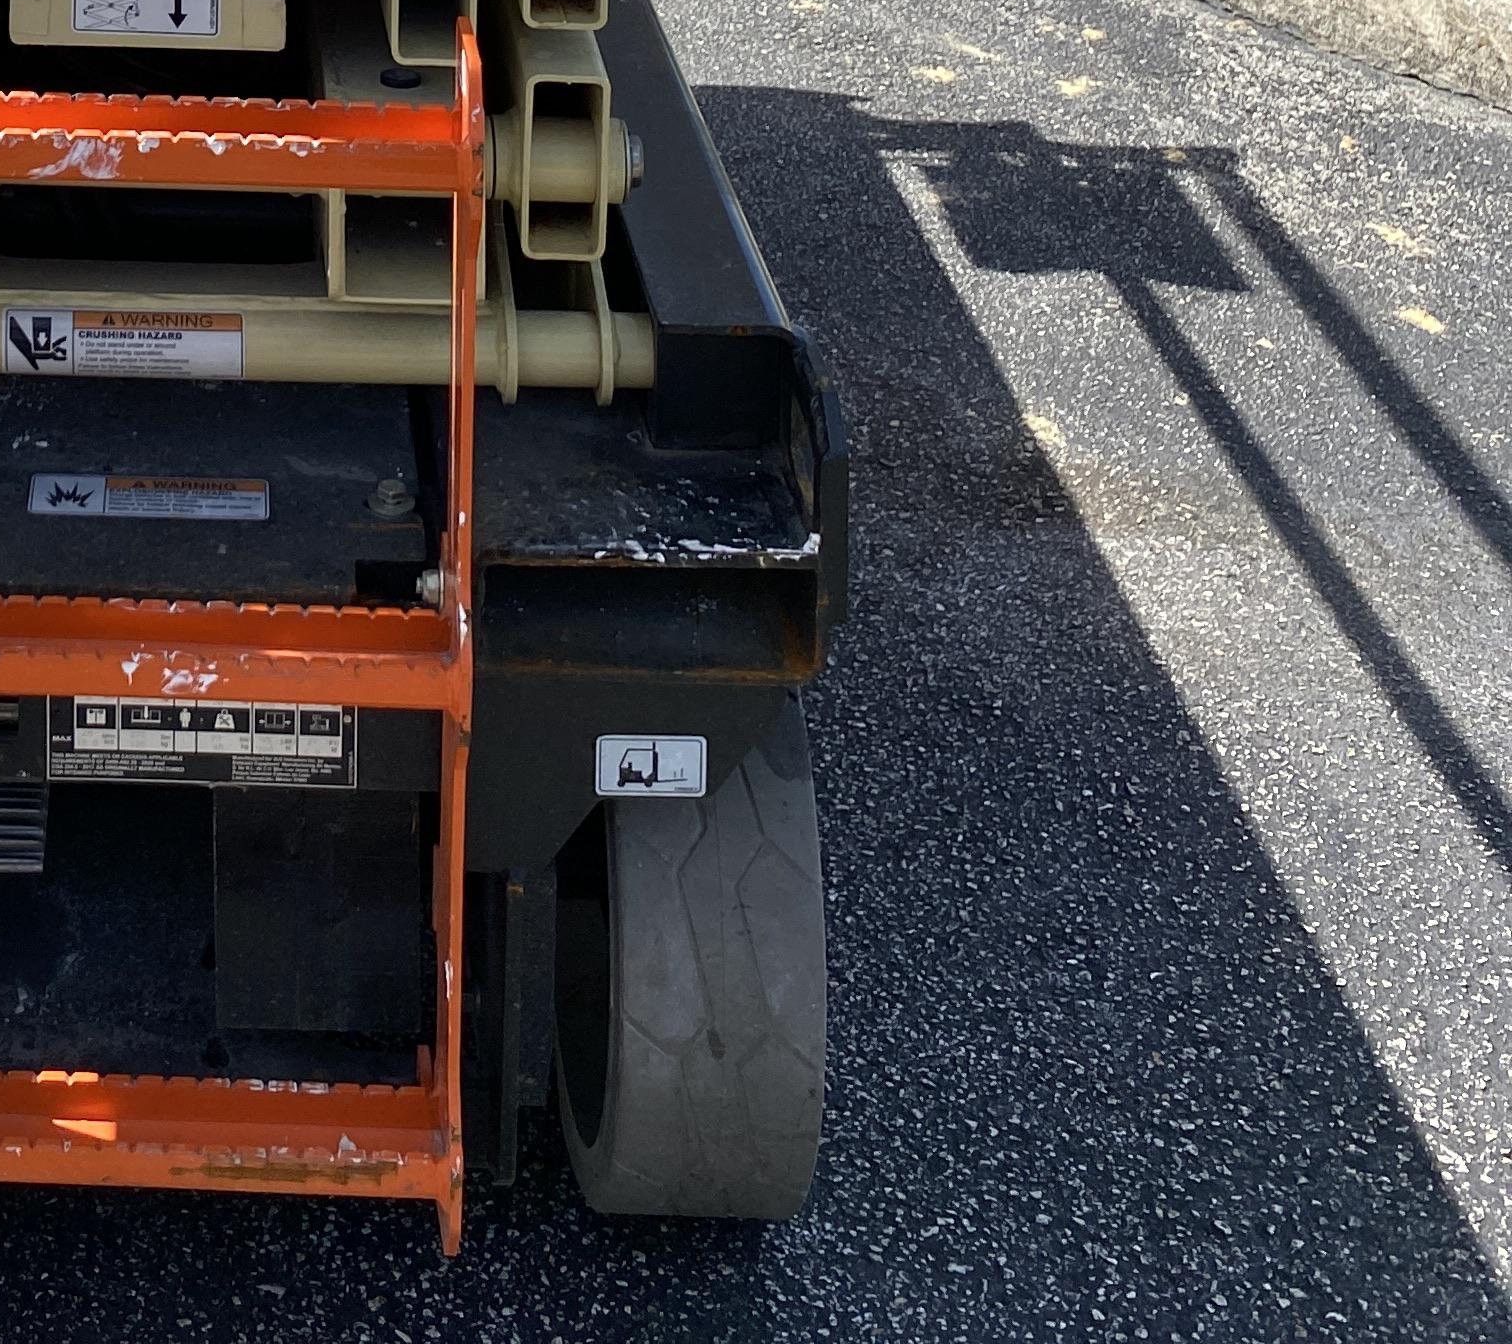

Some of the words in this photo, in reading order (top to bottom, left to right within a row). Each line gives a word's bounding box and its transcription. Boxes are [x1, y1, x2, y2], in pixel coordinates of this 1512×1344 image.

[121, 313, 214, 329] WARNING
[78, 330, 135, 340] CRUSHING
[138, 331, 183, 340] HAZARD
[152, 479, 237, 492] WARNING
